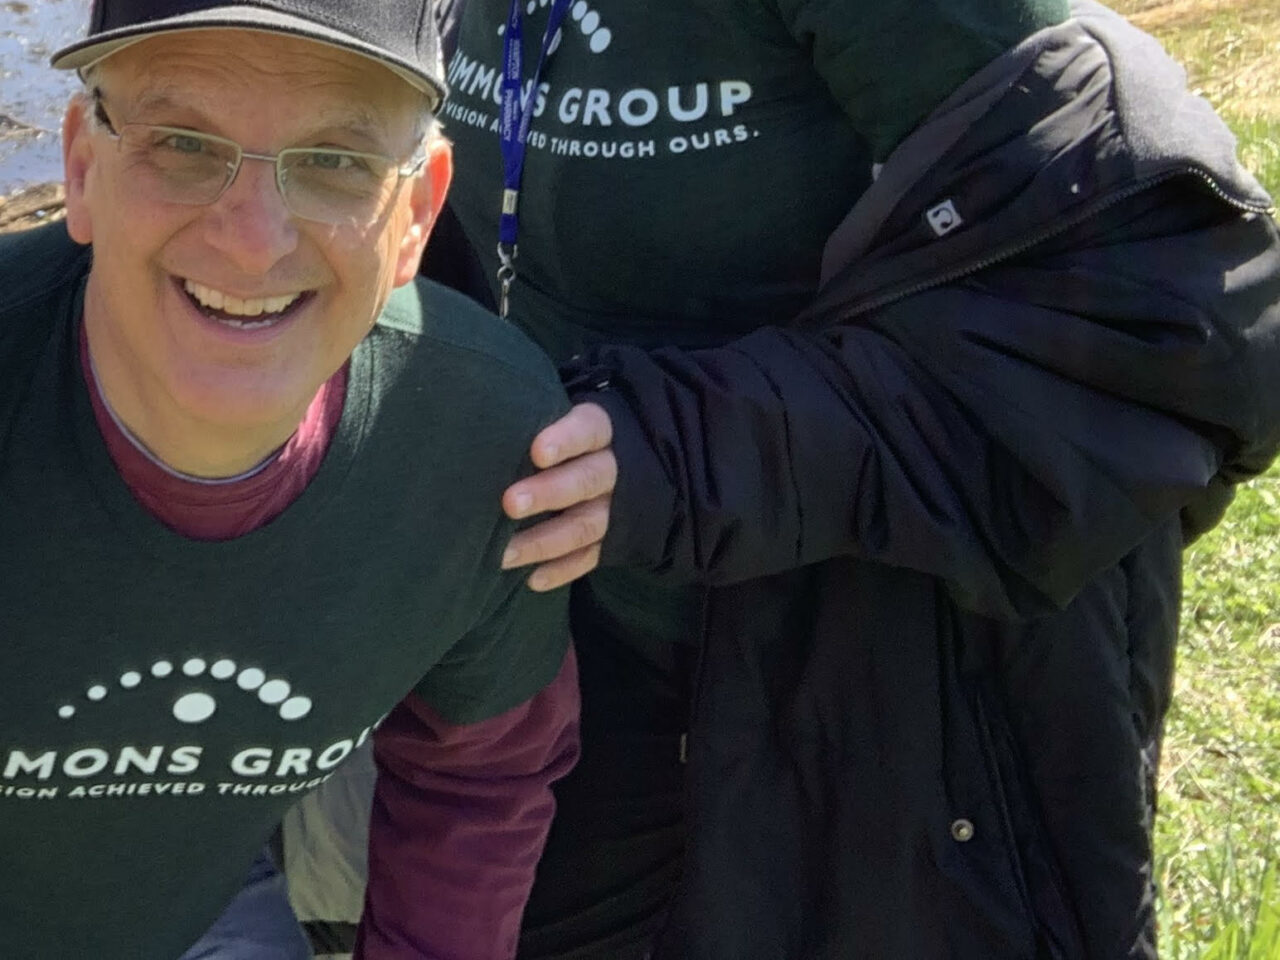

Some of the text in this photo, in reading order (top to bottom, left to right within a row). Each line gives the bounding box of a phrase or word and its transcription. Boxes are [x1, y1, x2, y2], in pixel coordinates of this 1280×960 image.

[558, 80, 752, 127] GROUP
[551, 137, 655, 158] THROUGH
[669, 124, 760, 153] OURS.
[68, 781, 205, 798] ACHIEVED
